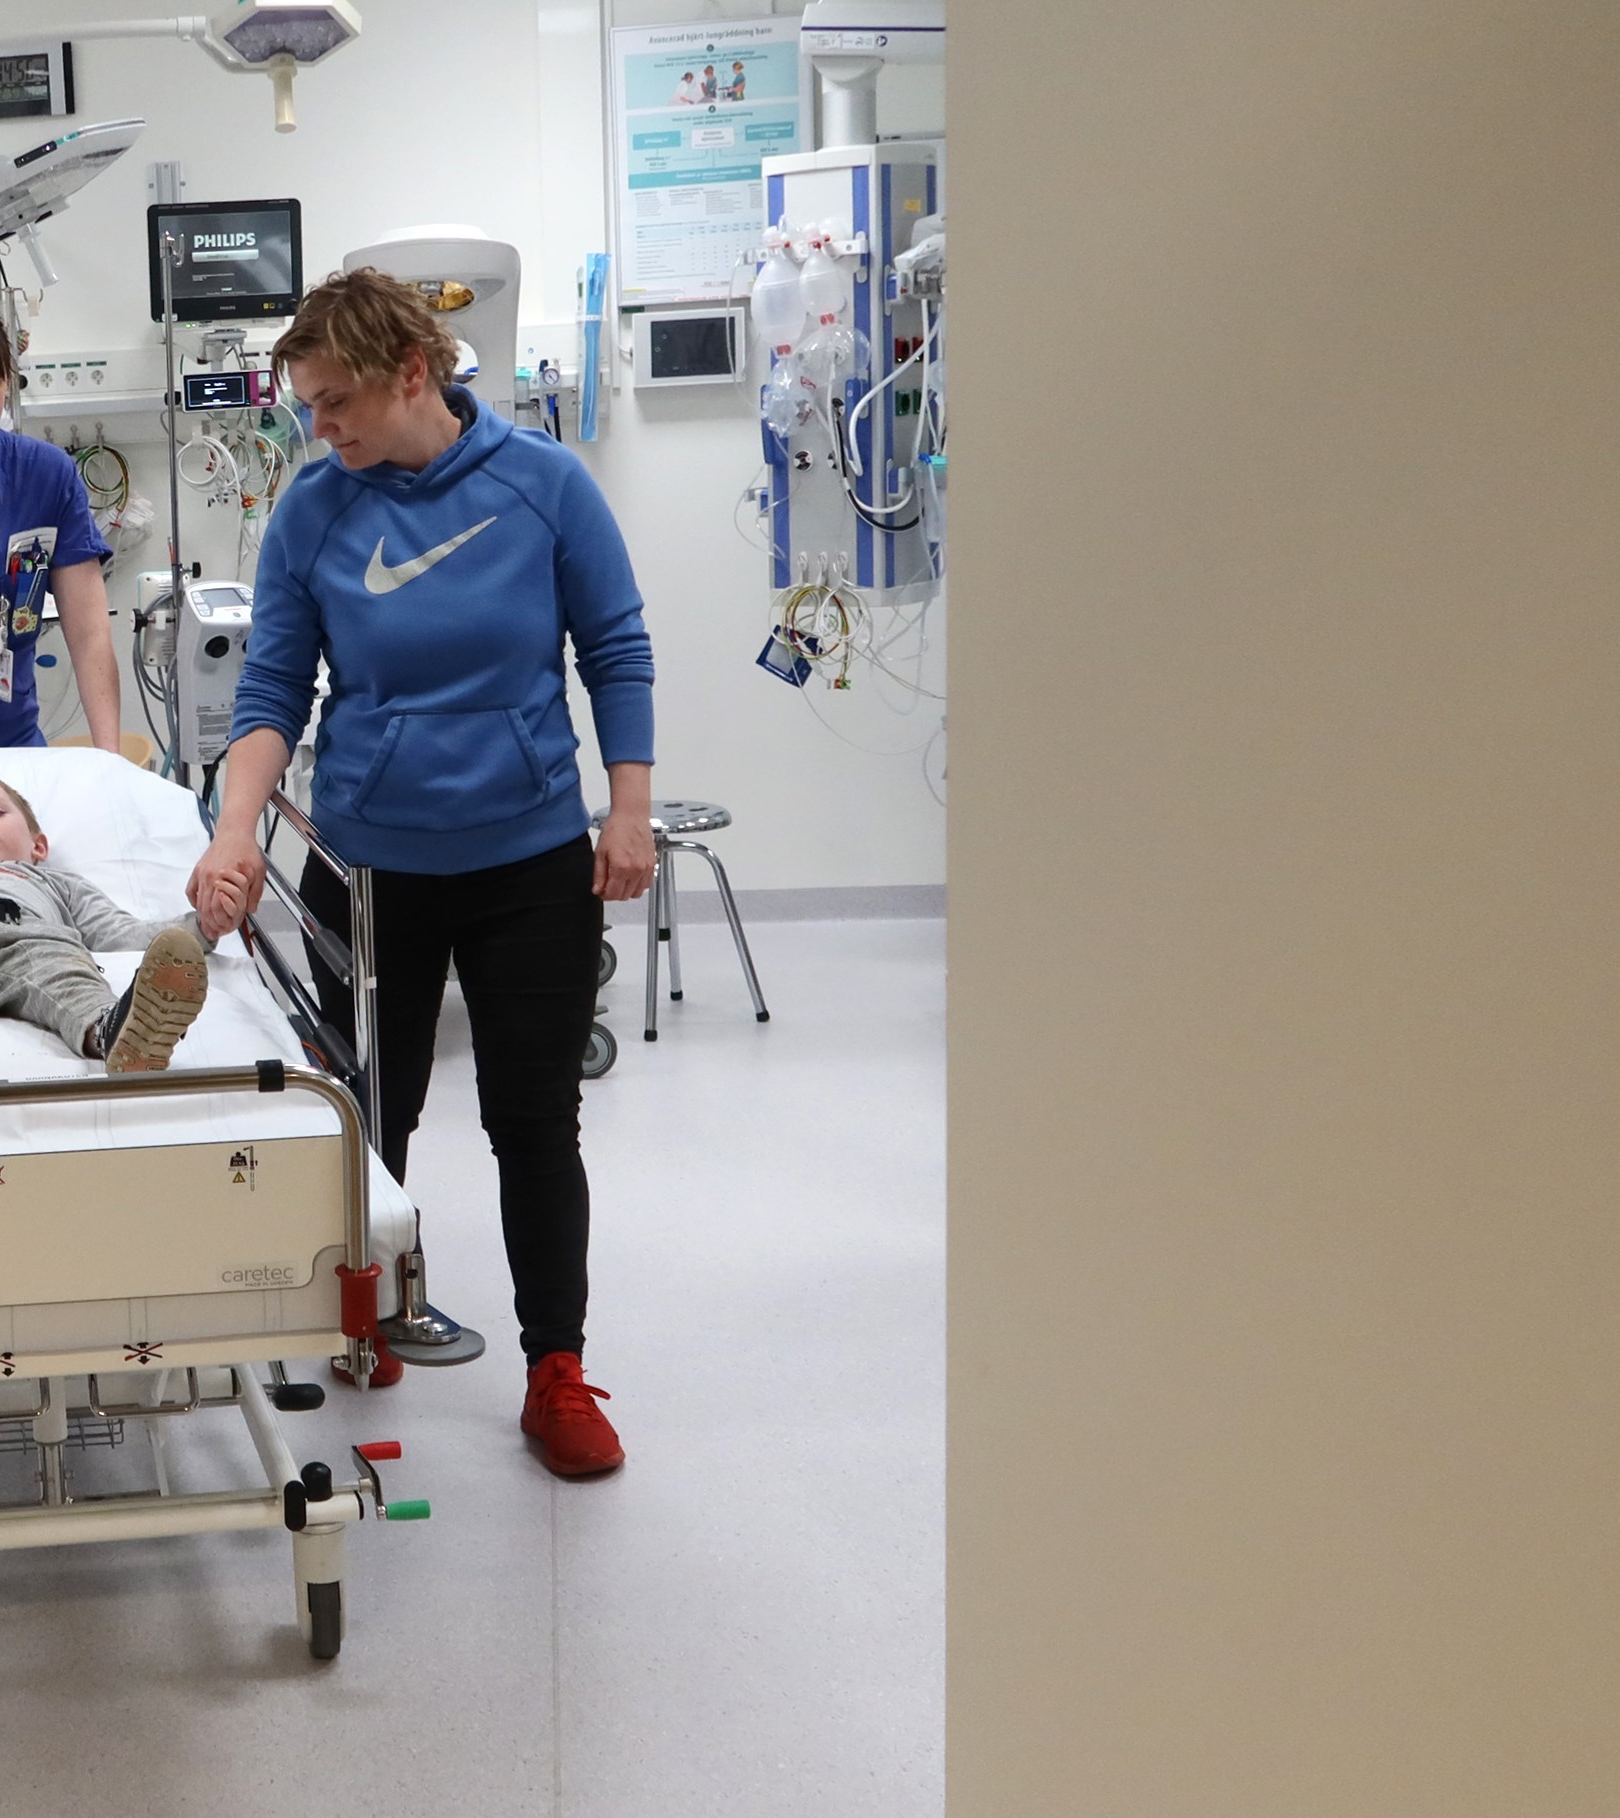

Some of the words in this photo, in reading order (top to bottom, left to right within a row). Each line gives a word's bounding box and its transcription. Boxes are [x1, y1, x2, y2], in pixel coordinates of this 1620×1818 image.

[649, 34, 684, 44] Avancerad
[193, 232, 257, 249] PHILIPS
[221, 1265, 294, 1283] caretec
